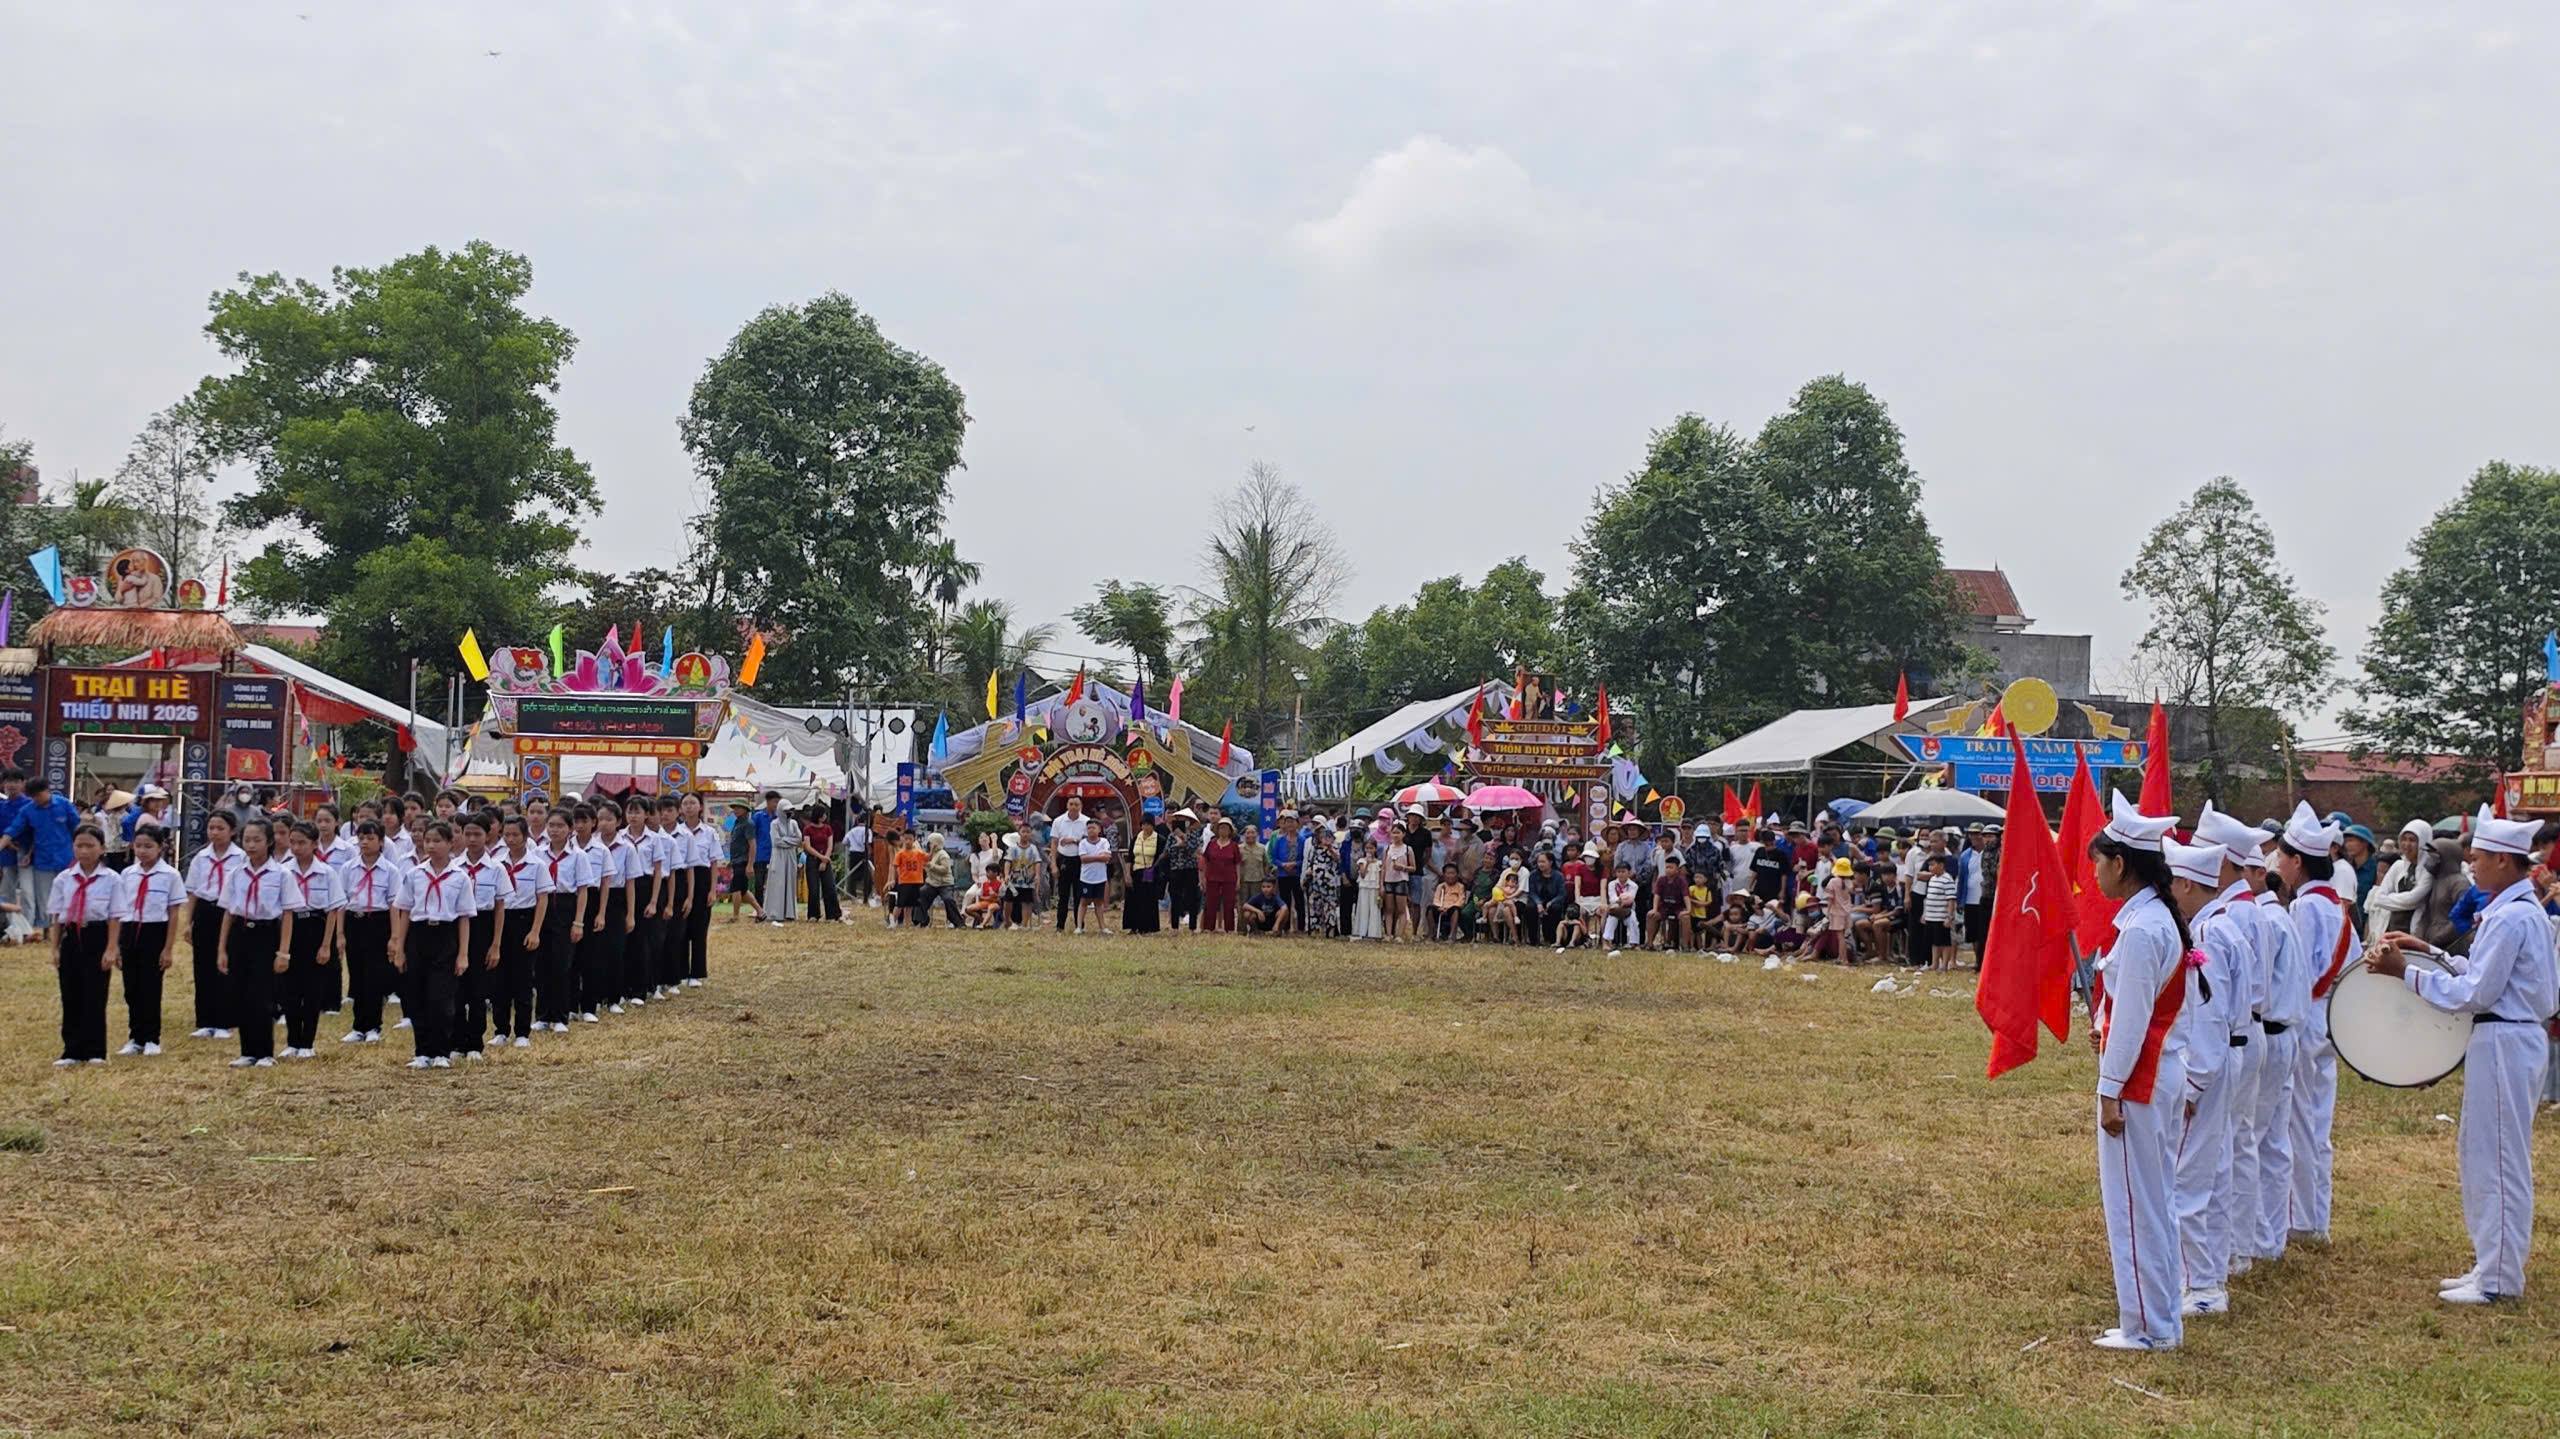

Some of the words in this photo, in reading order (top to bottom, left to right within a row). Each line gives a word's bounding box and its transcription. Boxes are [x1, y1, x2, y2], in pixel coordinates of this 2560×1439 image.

[71, 674, 136, 702] TRẠI
[148, 673, 190, 699] HÈ
[61, 698, 112, 719] THIẾU
[117, 704, 149, 720] NHI
[153, 704, 199, 721] 2026
